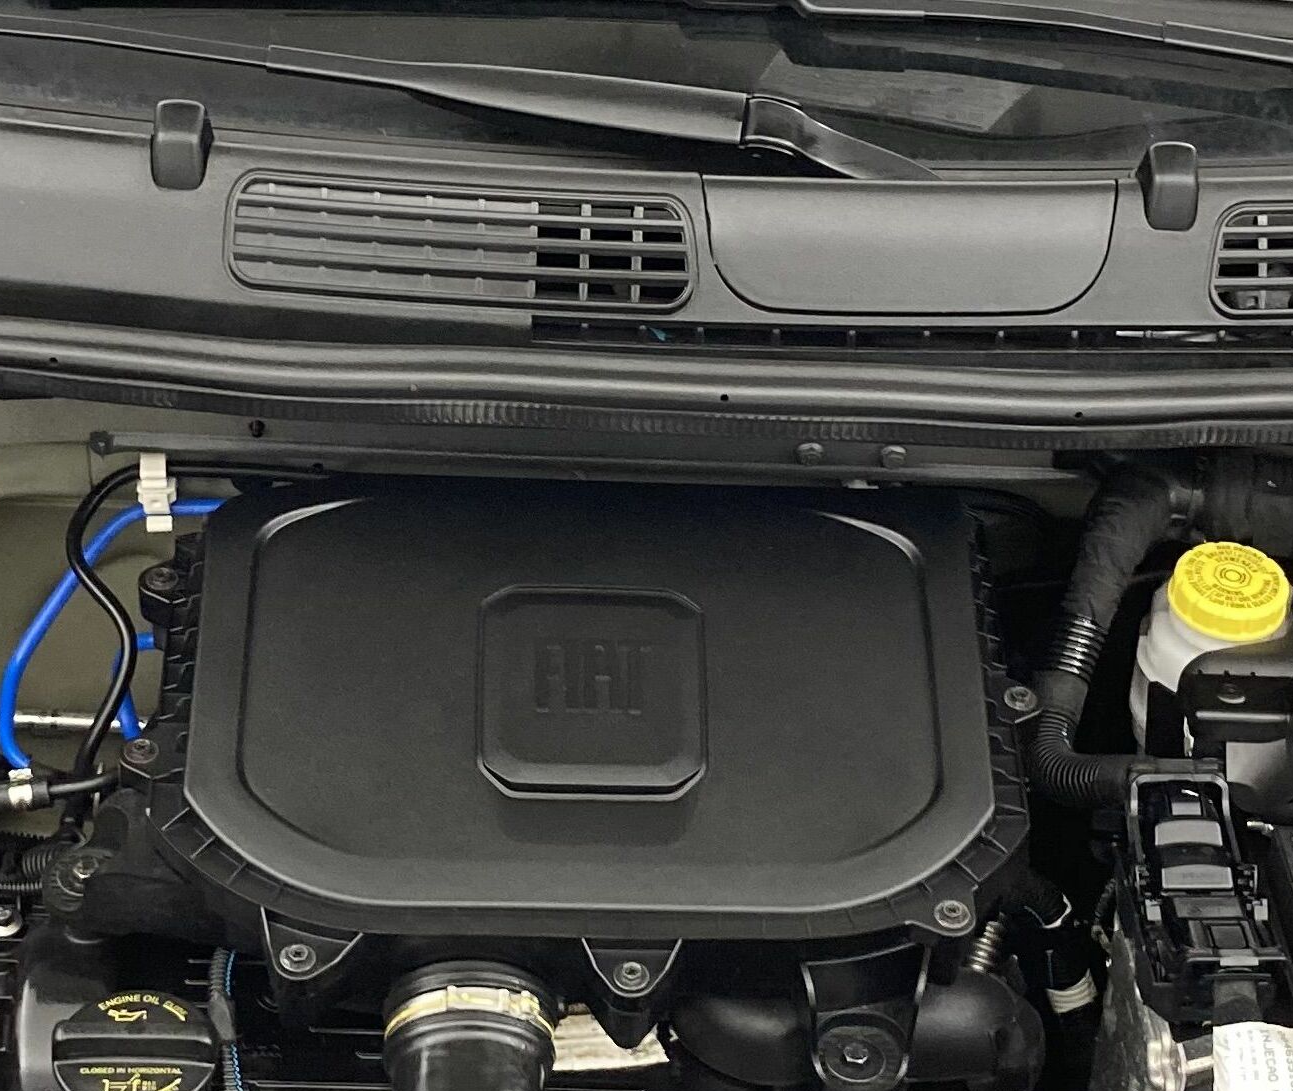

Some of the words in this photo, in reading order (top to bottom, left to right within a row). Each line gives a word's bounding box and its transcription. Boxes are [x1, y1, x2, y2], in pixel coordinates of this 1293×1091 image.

[533, 644, 652, 716] FIAT
[97, 994, 141, 1011] ENGINE
[142, 994, 160, 1005] OIL
[79, 1066, 115, 1074] CLOSED
[127, 1067, 183, 1075] HORIZONTAL
